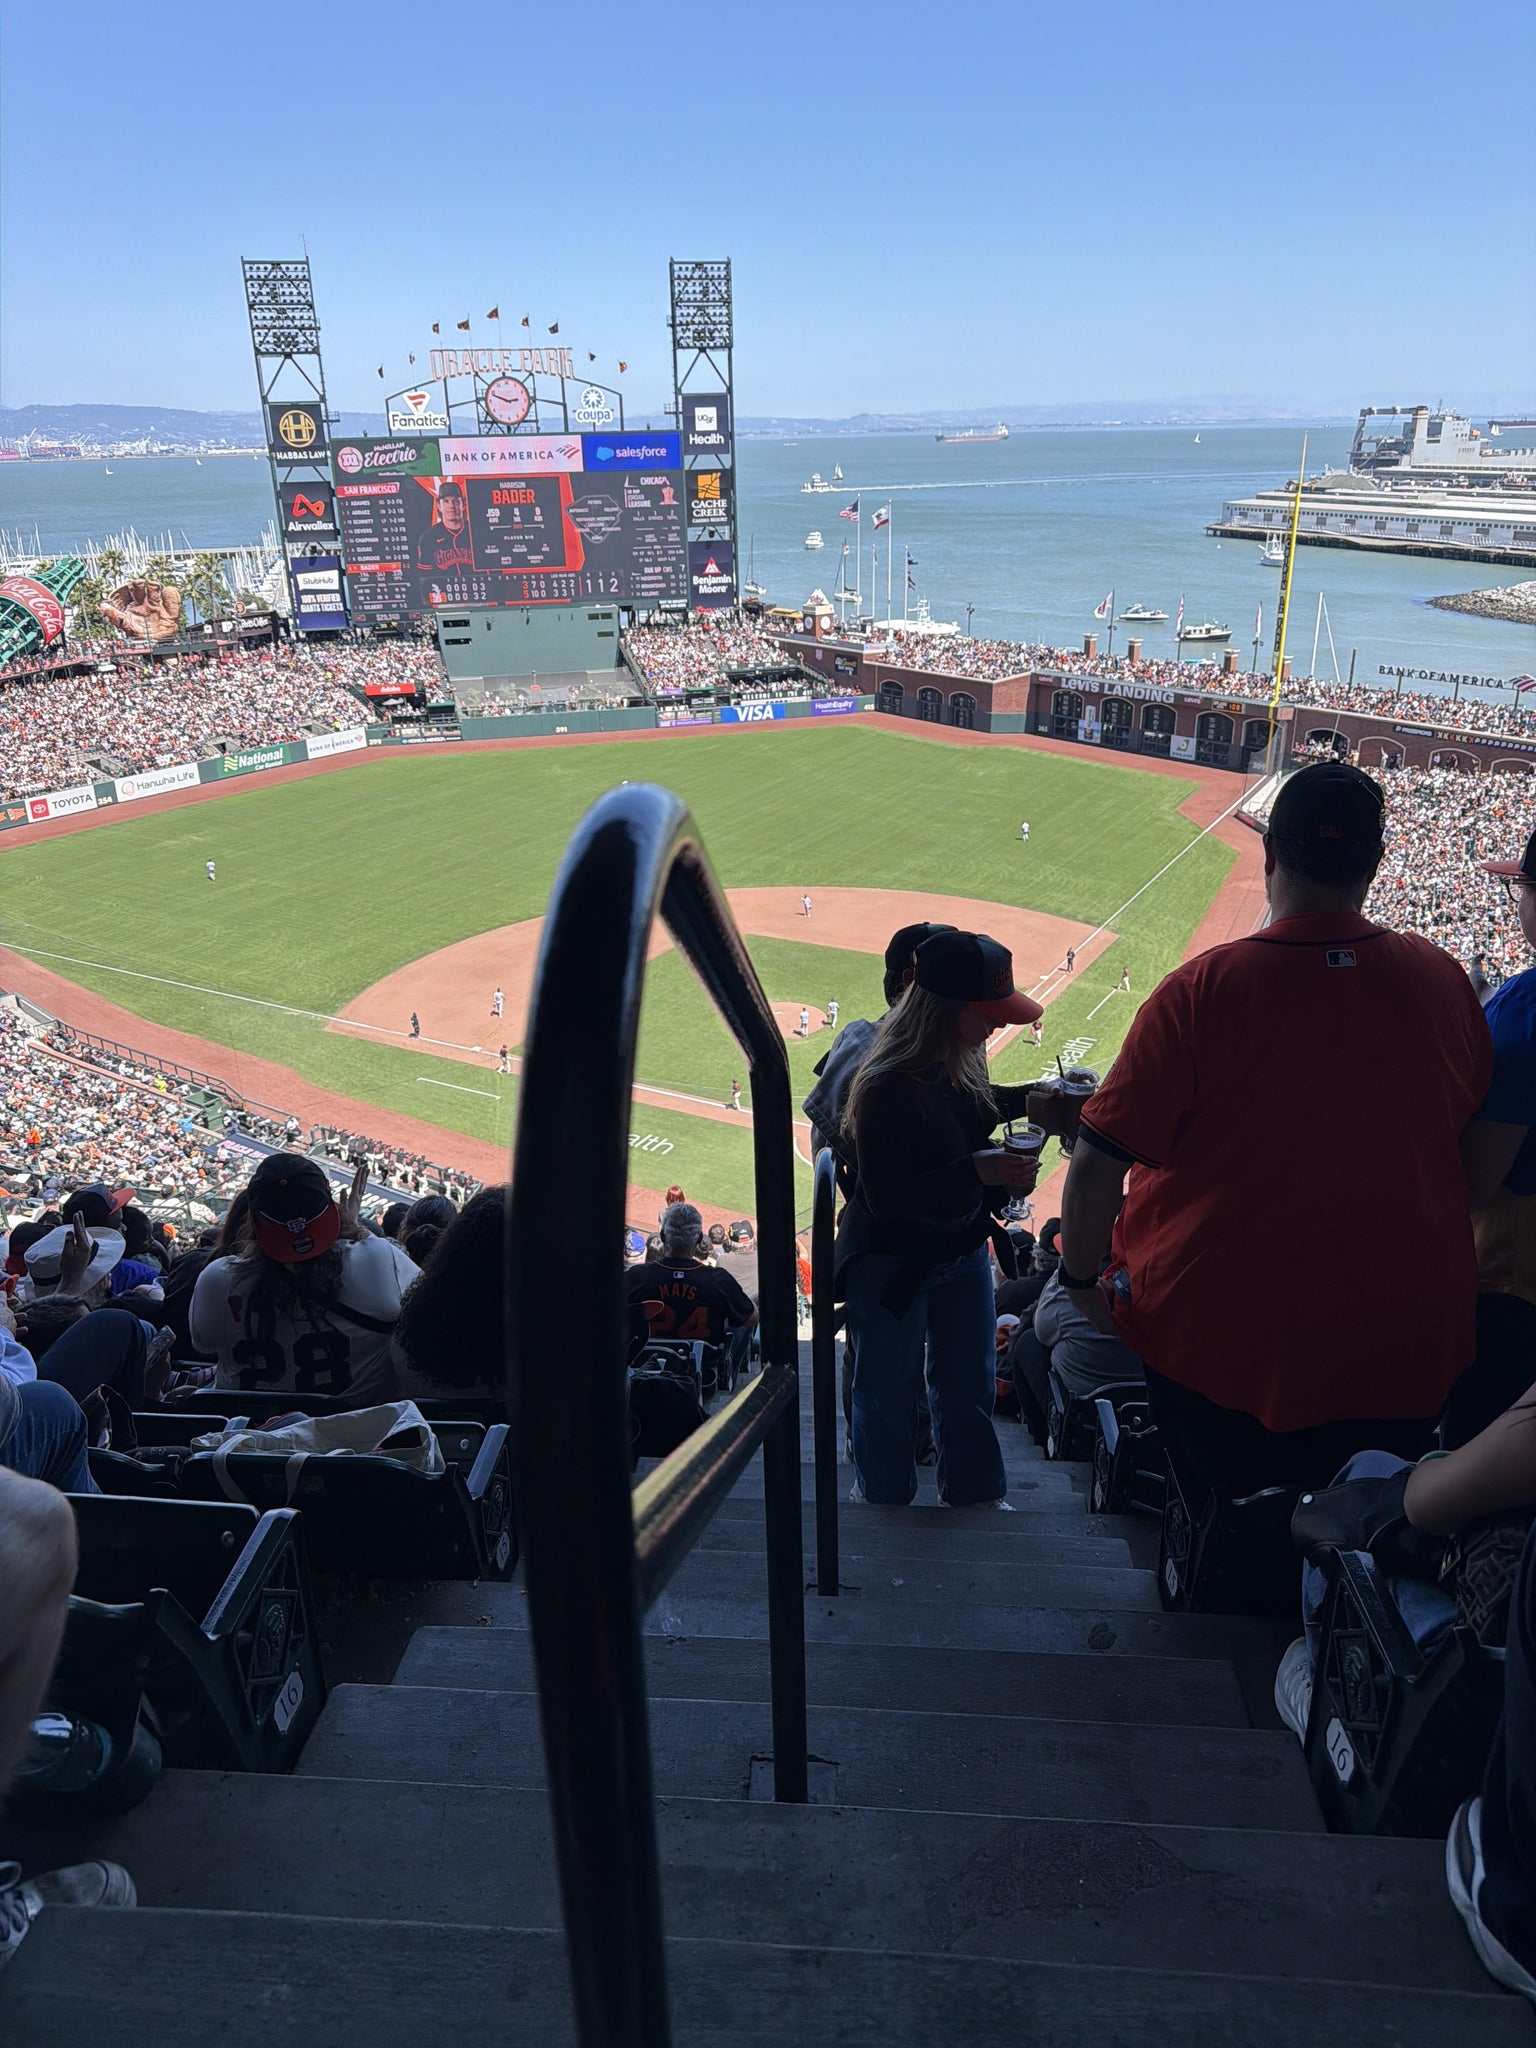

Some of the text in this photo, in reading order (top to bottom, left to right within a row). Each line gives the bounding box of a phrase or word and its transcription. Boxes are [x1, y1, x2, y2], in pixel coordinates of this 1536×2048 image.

[430, 347, 576, 380] ORACLE PARK
[392, 414, 447, 427] Fanatics
[577, 410, 612, 423] coupa
[689, 433, 725, 446] Health
[276, 450, 326, 460] HABBAS LAW
[363, 446, 417, 468] Electric
[444, 450, 554, 463] BANK OF AMERICA
[615, 445, 667, 460] salesforce
[343, 485, 396, 495] SAN FRANCISCO
[499, 481, 526, 489] HARRISON
[491, 488, 536, 505] BADER
[627, 500, 651, 508] LEASURE
[691, 499, 728, 509] CACHE
[692, 508, 727, 518] CREEK
[287, 520, 335, 532] Airwallex
[302, 576, 334, 585] StubHub
[446, 579, 575, 592] 0 0 0 0 3 3 7 0 4 2 2
[585, 577, 619, 594] 1 1 2
[692, 574, 732, 586] Benjamin
[447, 588, 575, 601] 0 0 0 3 2 5 10 0 3 3 1
[698, 584, 726, 594] Moore
[316, 592, 341, 603] VERIFIED
[300, 602, 345, 613] GIANTS TICKETS
[1378, 665, 1505, 690] BANK OF AMERICA
[1103, 683, 1175, 704] LANDING
[815, 700, 854, 711] HealthEquity
[733, 704, 774, 722] VISA
[238, 747, 284, 768] National
[137, 771, 195, 792] Hanwha Life
[52, 793, 93, 810] TOYOTA
[658, 1281, 698, 1301] MAYS
[644, 1303, 712, 1339] 24
[280, 1679, 298, 1719] 16
[1331, 1731, 1351, 1771] 16
